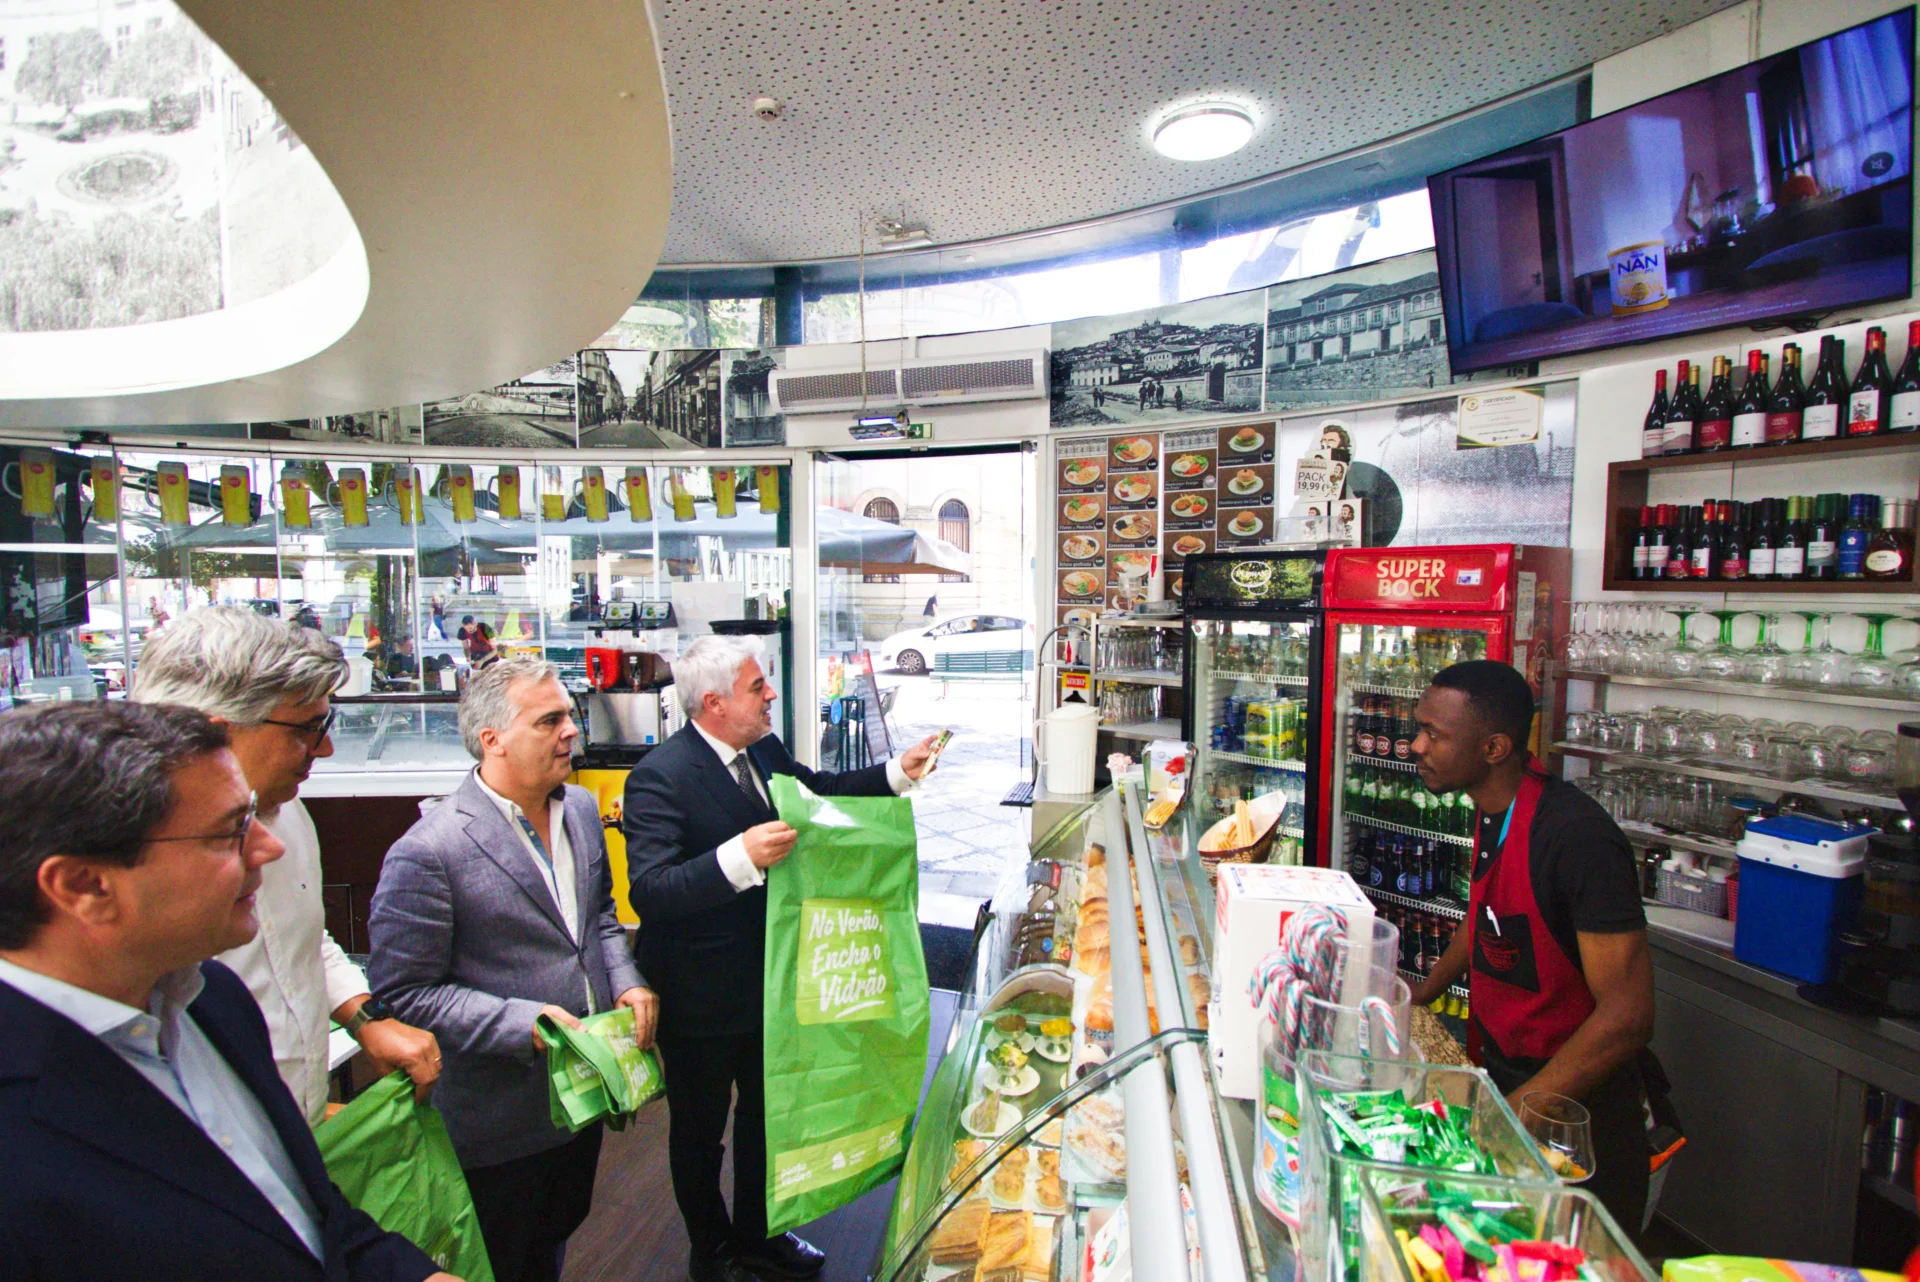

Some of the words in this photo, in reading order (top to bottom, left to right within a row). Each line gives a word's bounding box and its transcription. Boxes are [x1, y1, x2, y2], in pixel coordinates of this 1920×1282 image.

[1617, 254, 1658, 276] NAN
[1297, 481, 1320, 491] 19,99
[1298, 471, 1326, 482] PACK
[1376, 558, 1446, 579] SUPER
[1377, 578, 1442, 598] BOCK
[809, 907, 835, 941] No
[837, 907, 883, 937] Verão,
[811, 940, 872, 978] Encha
[873, 943, 881, 960] o
[819, 967, 887, 1013] Vidrão
